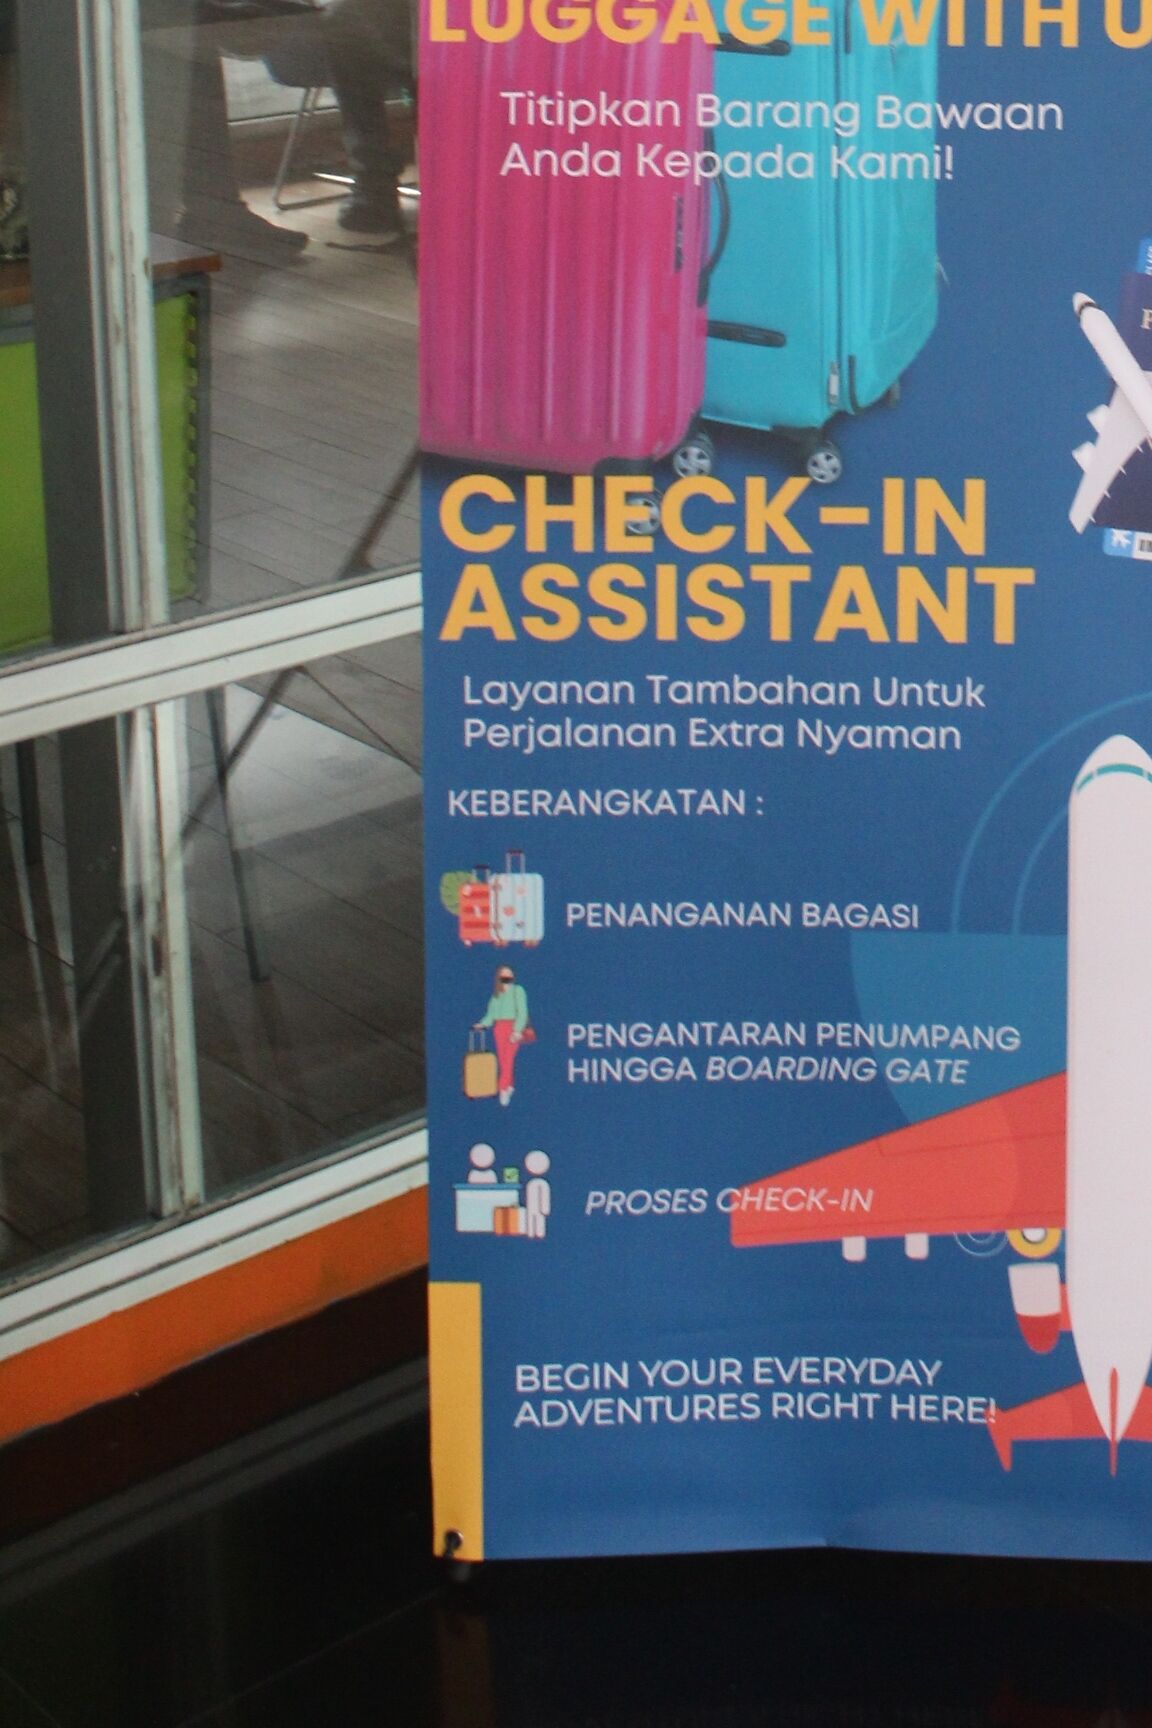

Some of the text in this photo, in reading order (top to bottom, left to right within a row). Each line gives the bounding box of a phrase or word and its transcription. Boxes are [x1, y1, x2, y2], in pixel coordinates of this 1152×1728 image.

[499, 90, 1063, 138] Titipkan Barang Bawaan
[500, 143, 953, 186] Anda Kepada Kami!
[440, 474, 984, 554] CHECK-IN
[441, 563, 1034, 643] ASSISTANT
[464, 674, 986, 711] Layanan Tambahan Untuk
[464, 717, 961, 755] Perjalanan Extra Nyaman
[448, 789, 745, 816] KEBERANGKATAN
[567, 902, 918, 929] PENANGANAN BAGASI
[567, 1022, 1021, 1051] PENGANTARAN PENUMPANG
[568, 1056, 969, 1084] HINGGA BOARDING GATE
[585, 1187, 874, 1215] PROSES CHECK-IN
[516, 1357, 940, 1392] BEGIN YOUR EVERYDAY
[514, 1392, 996, 1427] ADVENTURES RIGHT HERE!
